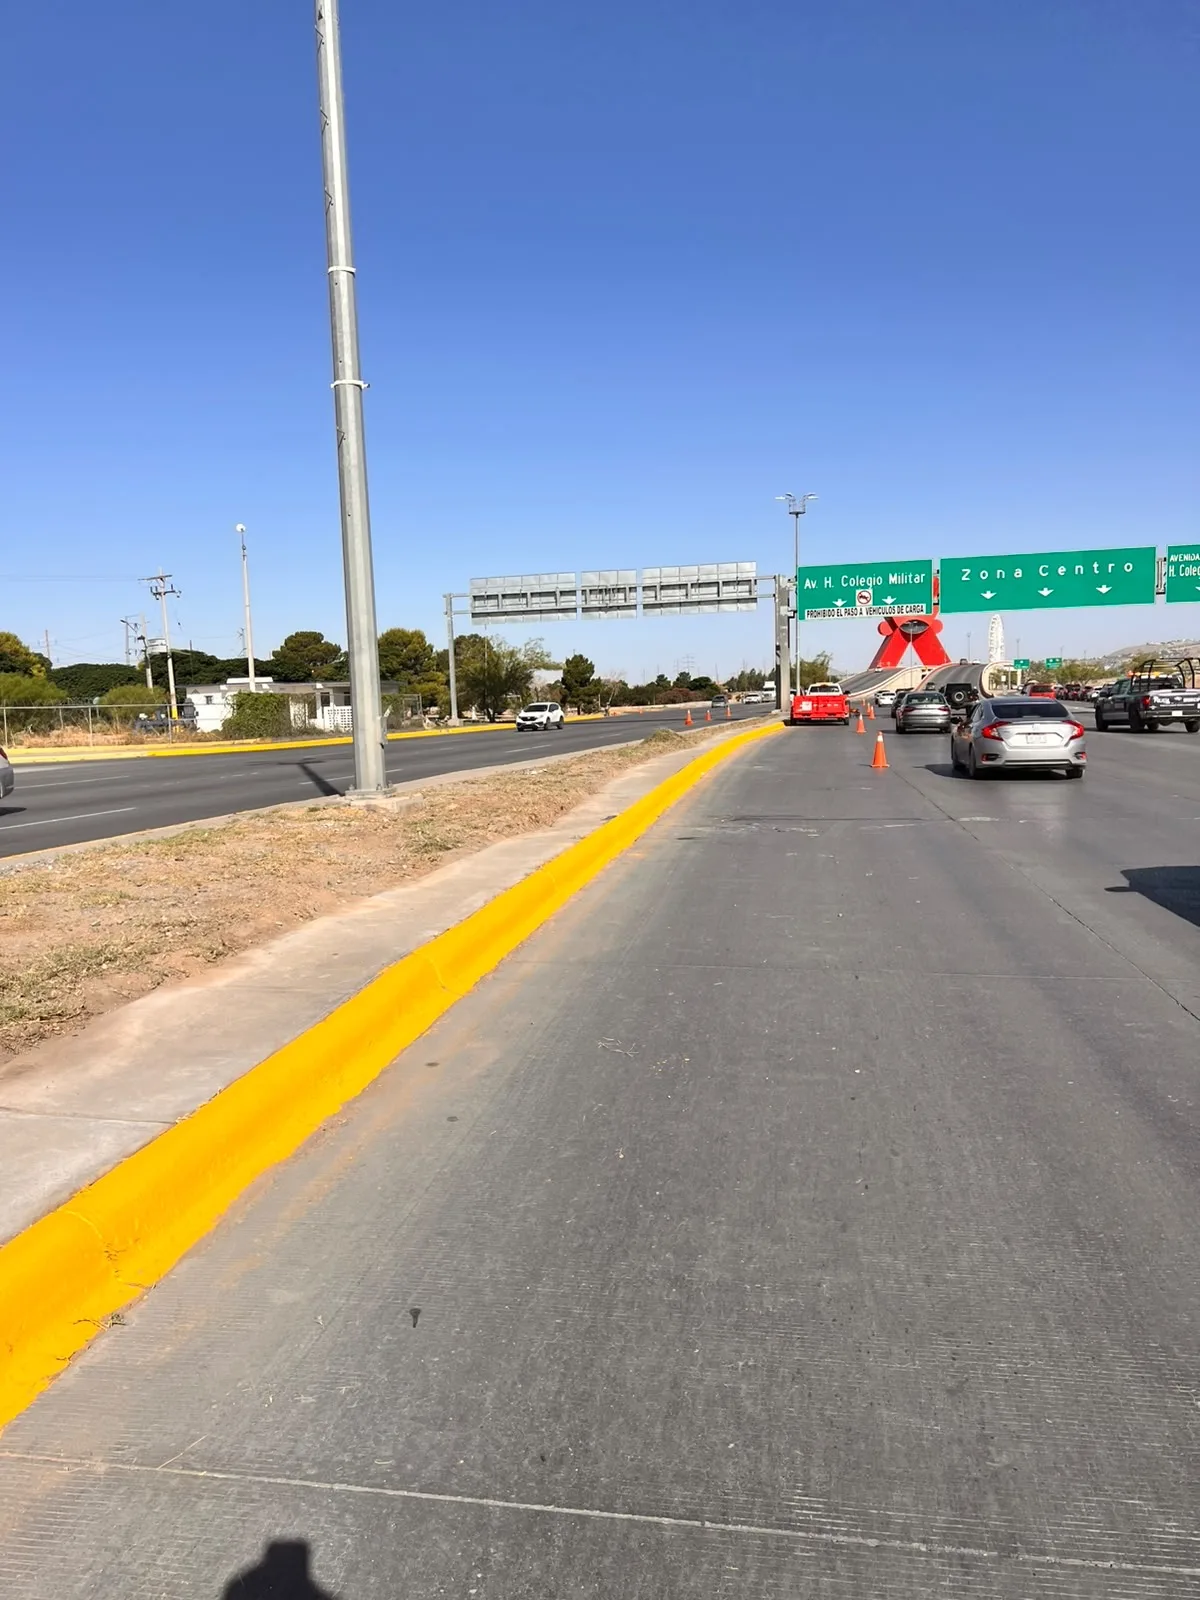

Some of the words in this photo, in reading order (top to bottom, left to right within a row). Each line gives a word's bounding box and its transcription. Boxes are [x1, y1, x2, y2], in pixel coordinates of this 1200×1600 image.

[1170, 553, 1200, 562] AVENIDA
[961, 568, 1023, 581] Zona
[1038, 561, 1133, 577] Centro
[804, 577, 818, 590] Av.
[824, 576, 834, 588] H.
[841, 574, 883, 589] Colegio
[888, 572, 925, 585] Militar
[806, 608, 835, 618] PROHIBIDO
[836, 608, 843, 617] EL
[844, 607, 858, 616] PASO
[865, 605, 896, 615] VEHICULOS
[897, 605, 904, 614] DE
[905, 604, 924, 614] CARGA
